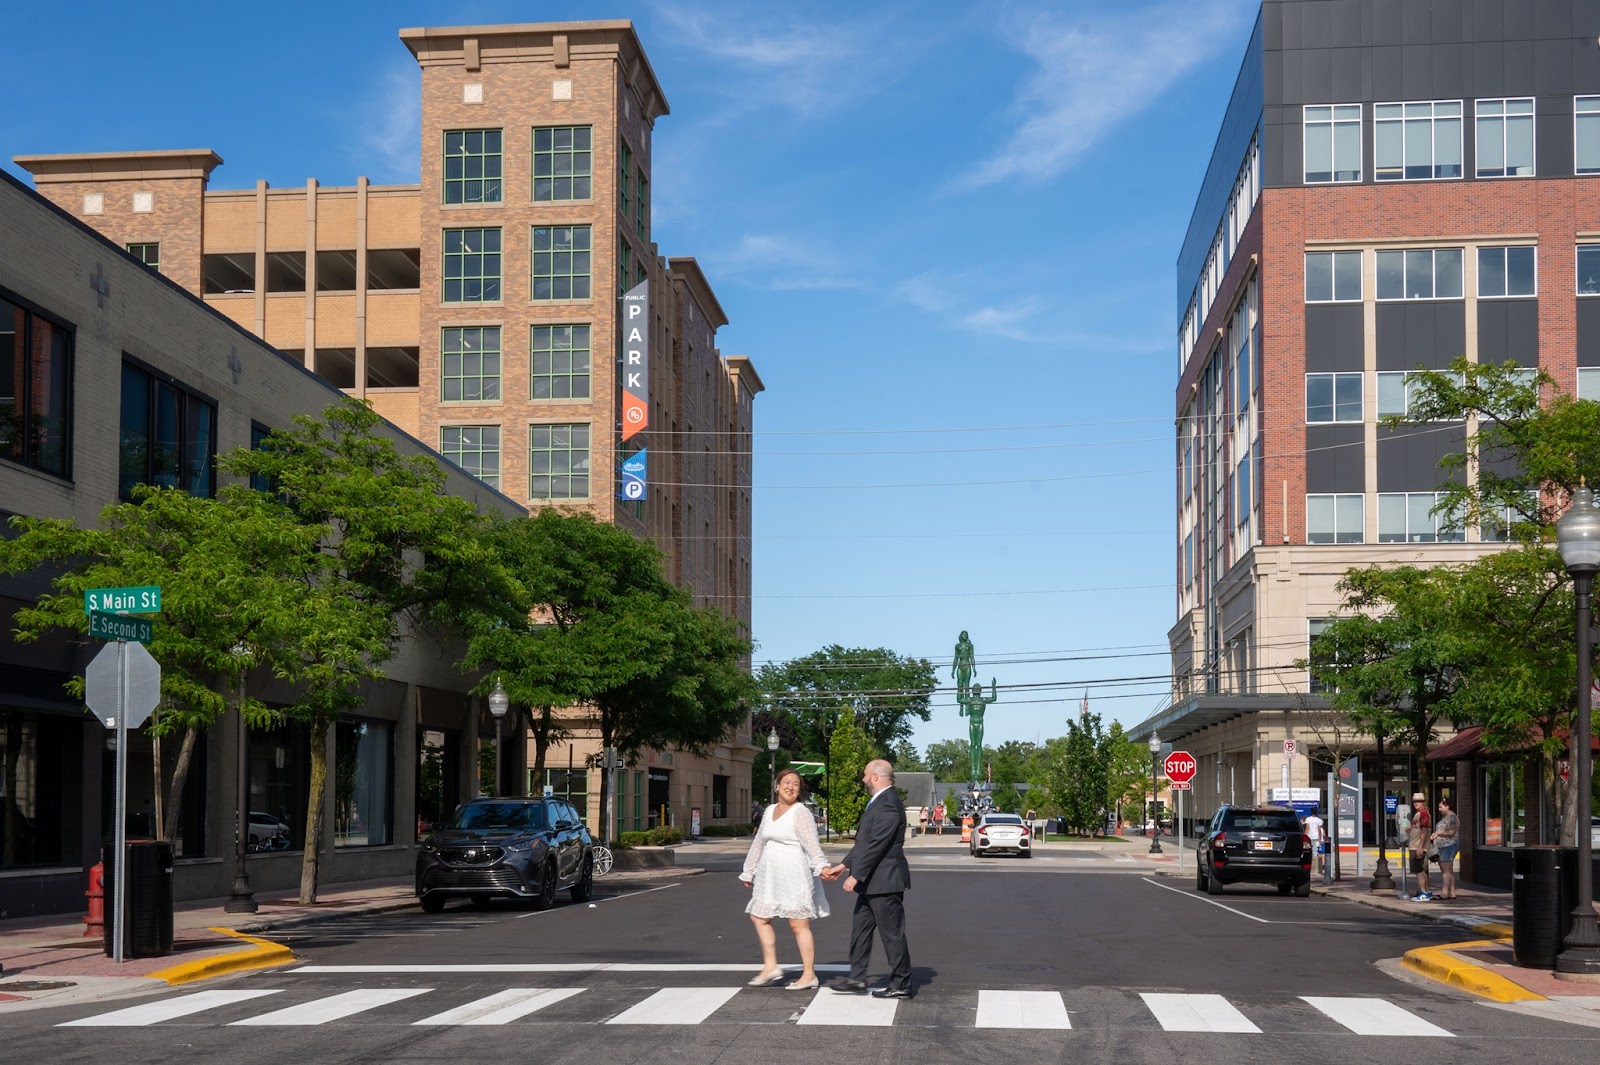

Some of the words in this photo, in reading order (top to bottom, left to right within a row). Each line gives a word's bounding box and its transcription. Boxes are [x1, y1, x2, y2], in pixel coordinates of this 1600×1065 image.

[628, 305, 642, 387] PARK
[103, 593, 136, 609] Main
[141, 592, 157, 608] St
[101, 617, 137, 638] Second
[140, 624, 151, 640] St
[1167, 761, 1194, 773] STOP
